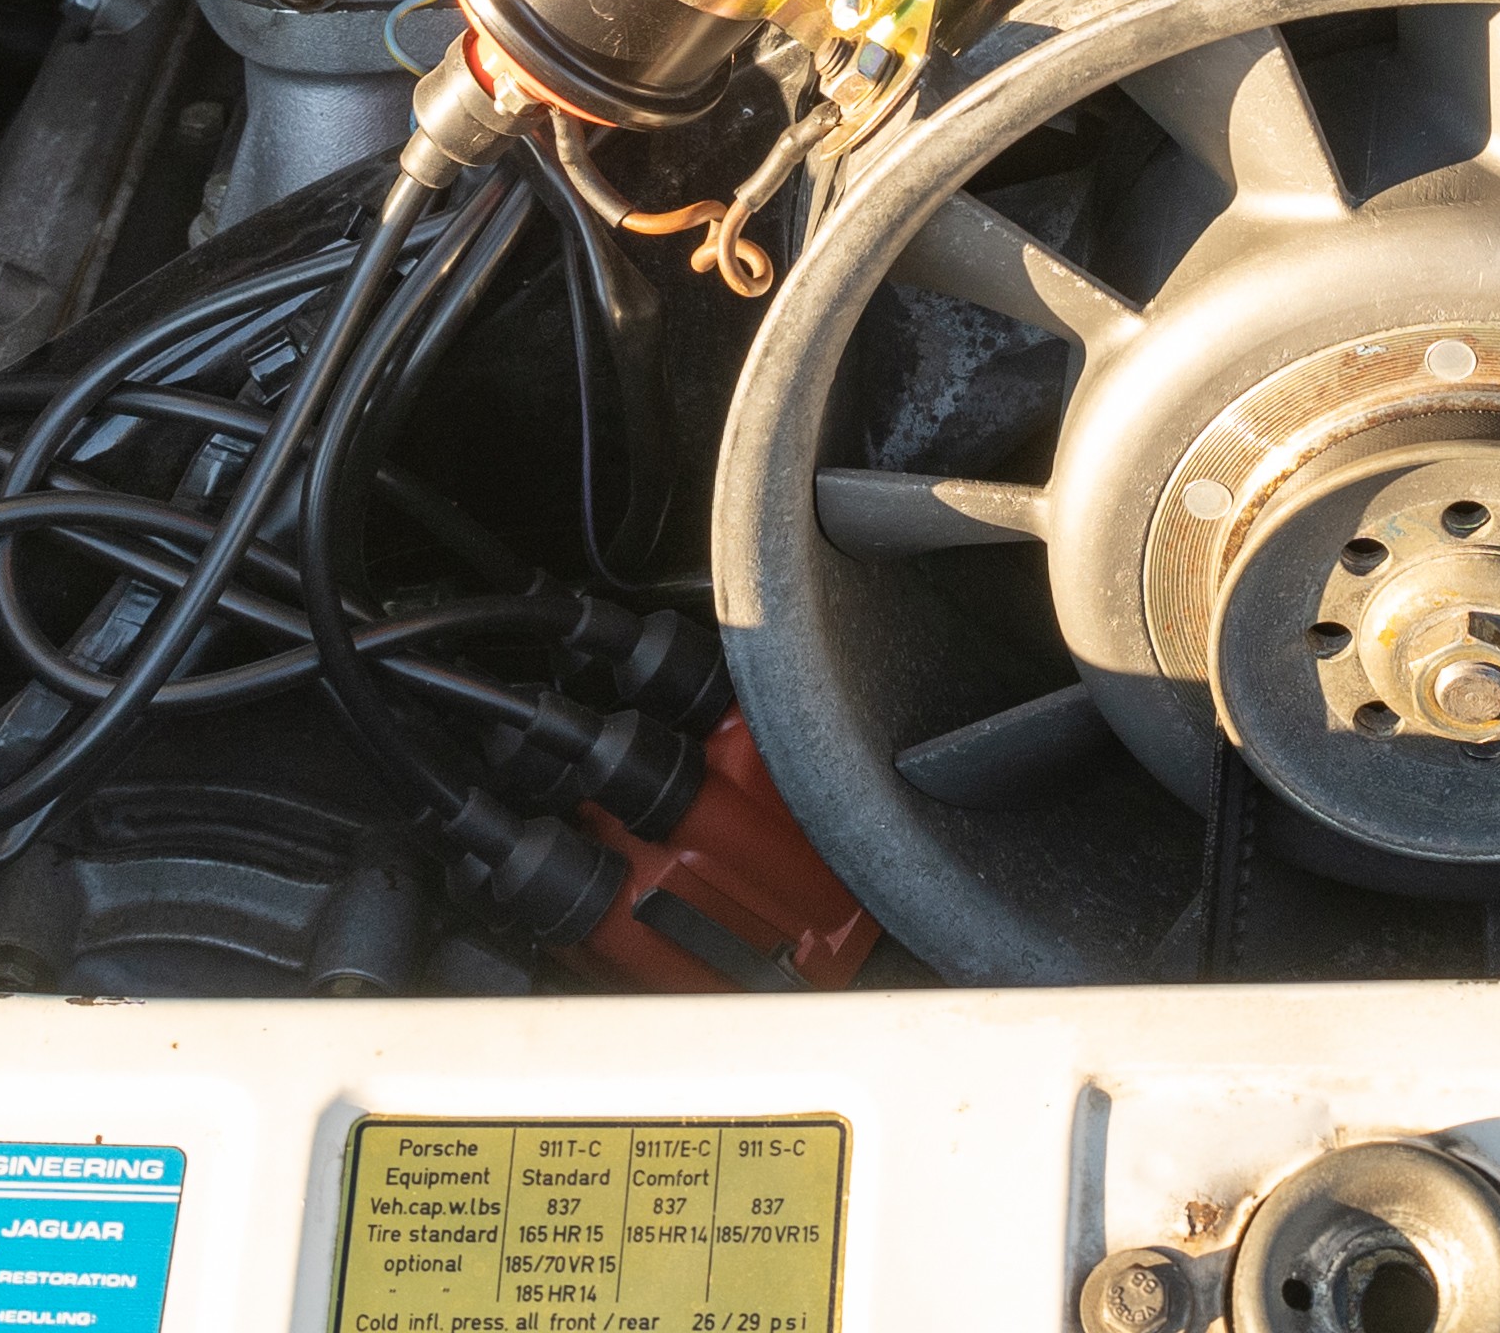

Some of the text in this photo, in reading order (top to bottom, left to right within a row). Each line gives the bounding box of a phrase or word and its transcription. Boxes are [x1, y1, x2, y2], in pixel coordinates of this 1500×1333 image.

[398, 1138, 479, 1158] Porsche
[769, 1139, 806, 1157] S-C
[385, 1167, 491, 1190] Equipment
[521, 1168, 611, 1187] Standard
[632, 1168, 710, 1187] Comfort
[546, 1197, 582, 1216] 837
[652, 1197, 688, 1215] 837
[751, 1197, 785, 1216] 837
[0, 1218, 125, 1241] JAGUAR
[367, 1223, 499, 1244] Tire standard
[383, 1254, 463, 1277] optional
[355, 1311, 661, 1333] Cold infl. press. all front rear
[691, 1312, 716, 1332] 26
[736, 1312, 761, 1332] 29
